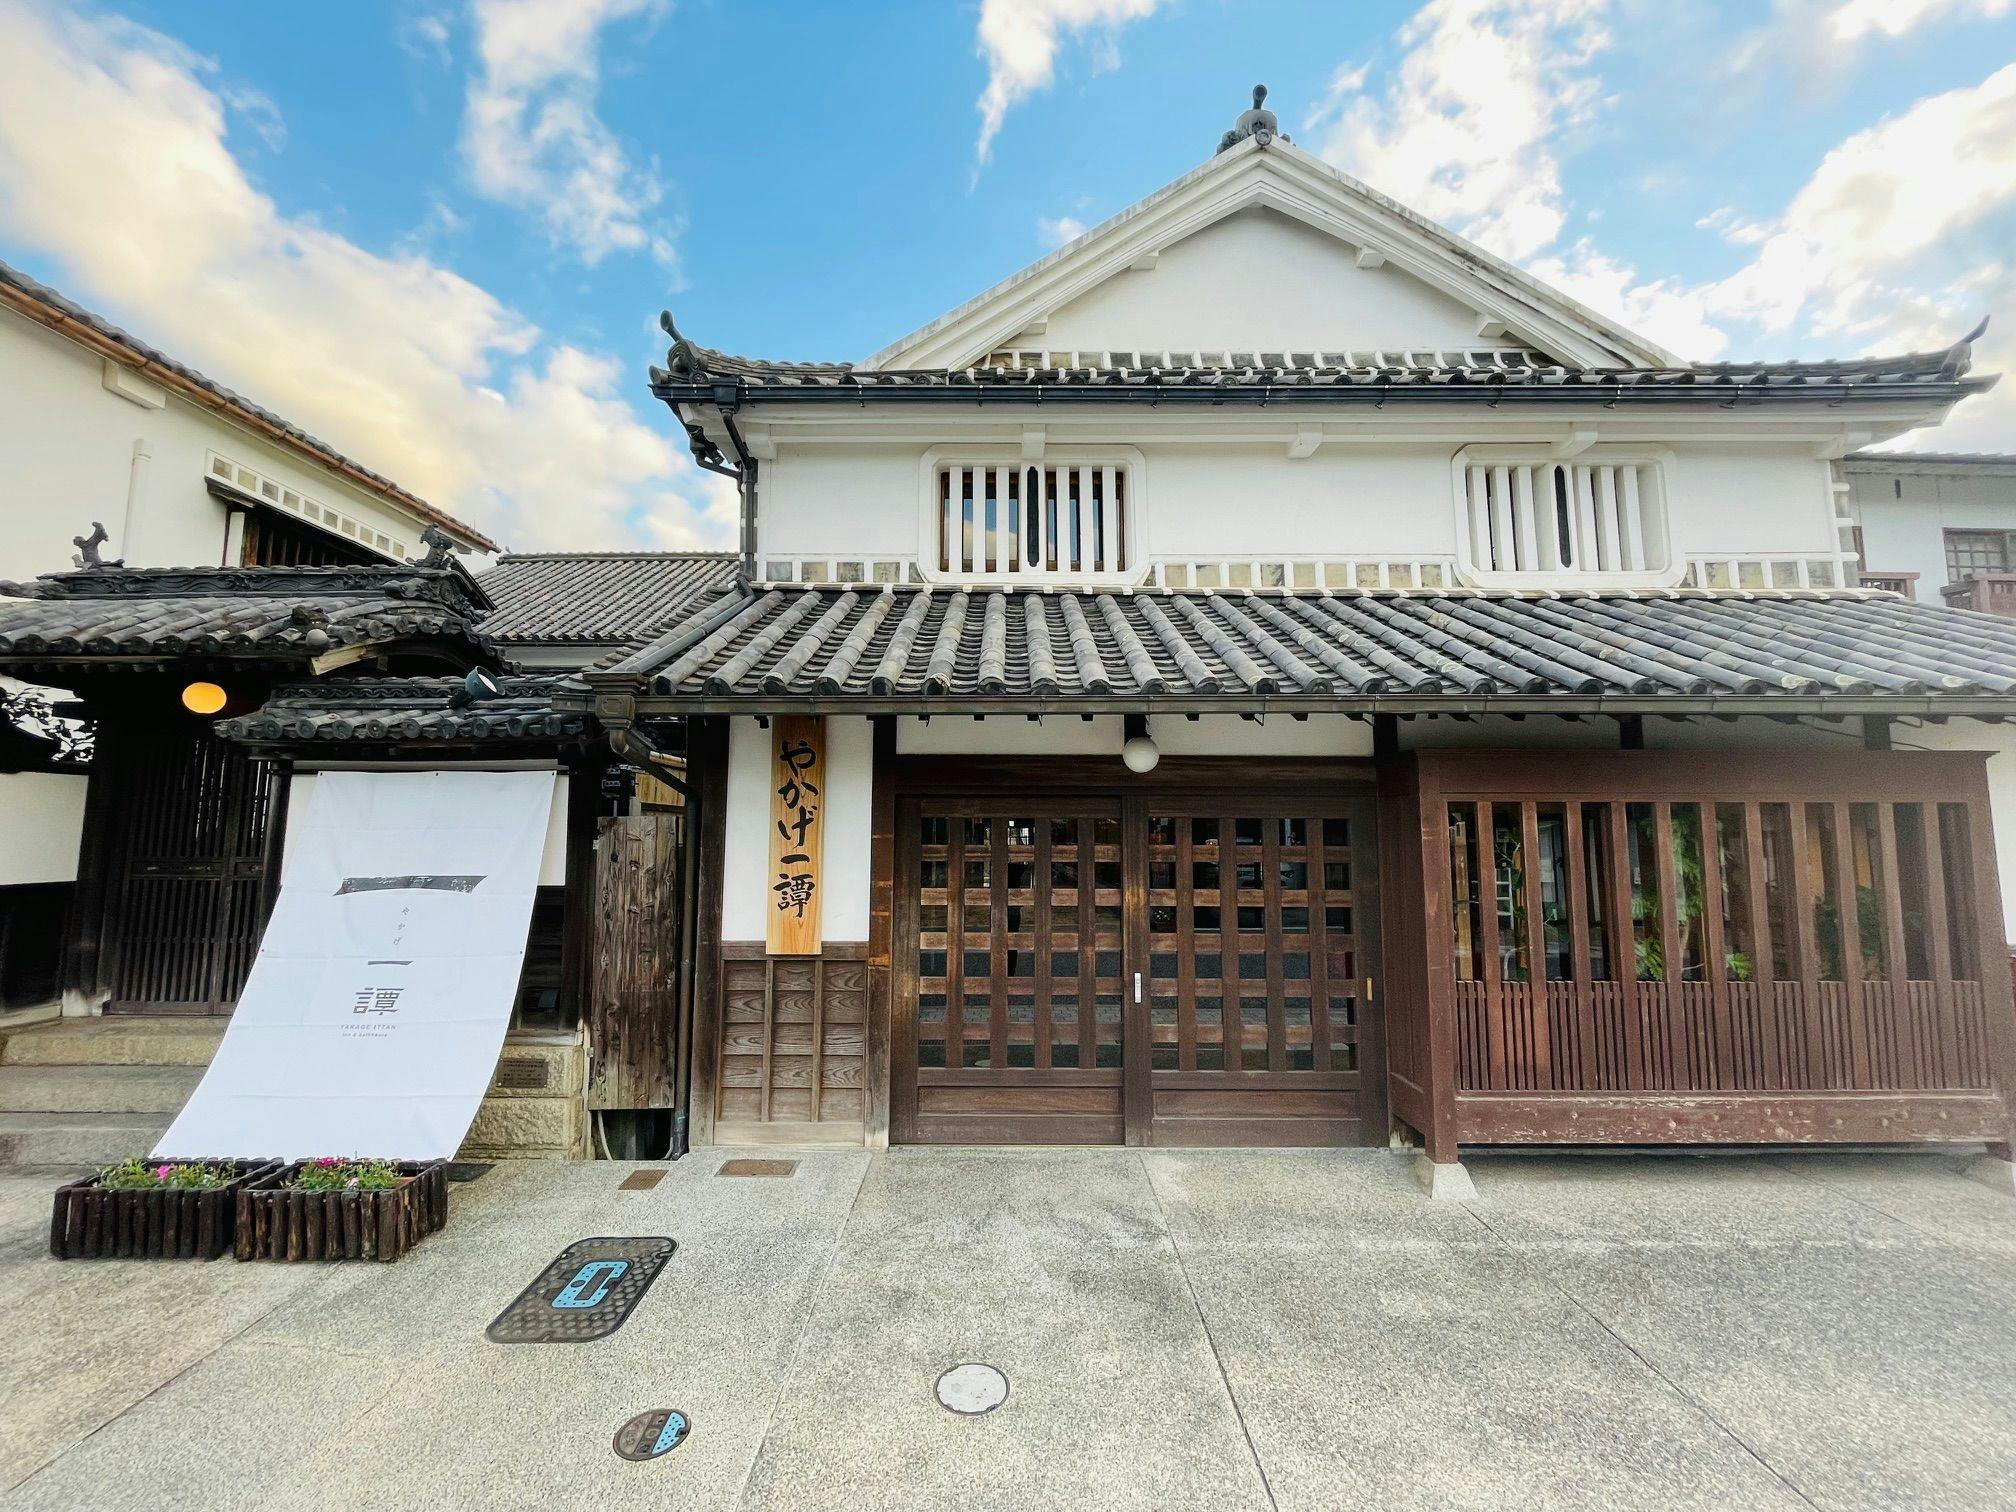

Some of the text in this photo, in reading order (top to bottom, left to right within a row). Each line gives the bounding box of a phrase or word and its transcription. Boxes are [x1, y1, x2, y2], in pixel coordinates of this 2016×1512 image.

[773, 739, 819, 918] やかげ一譚
